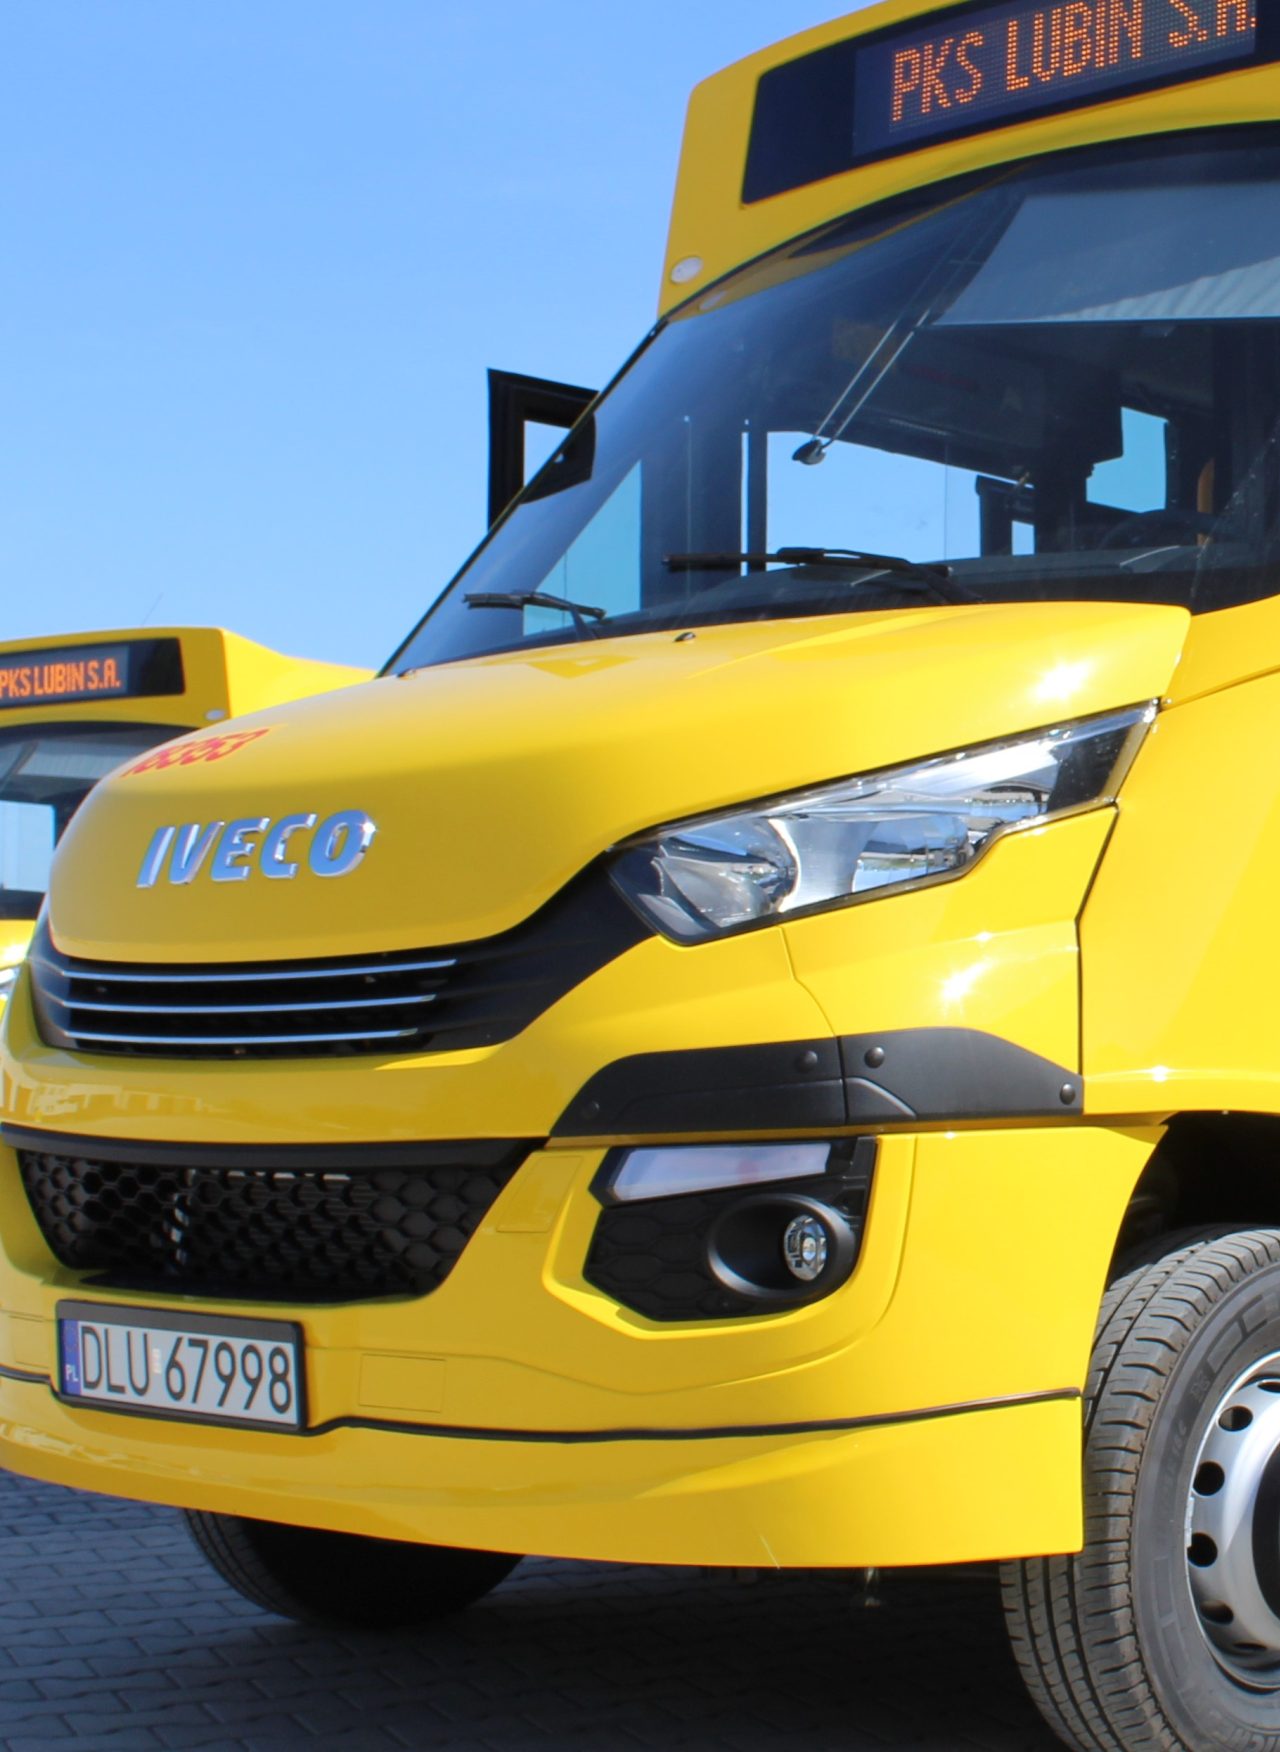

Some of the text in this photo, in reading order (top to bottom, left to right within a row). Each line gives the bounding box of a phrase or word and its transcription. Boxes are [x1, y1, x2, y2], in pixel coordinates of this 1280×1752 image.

[892, 31, 984, 121] PKS
[1006, 0, 1143, 91] LUBIN
[0, 658, 121, 698] PKS LUBIN S.A.
[136, 809, 377, 888] IVECO
[65, 1363, 79, 1382] PL
[81, 1325, 292, 1414] DLU 67998
